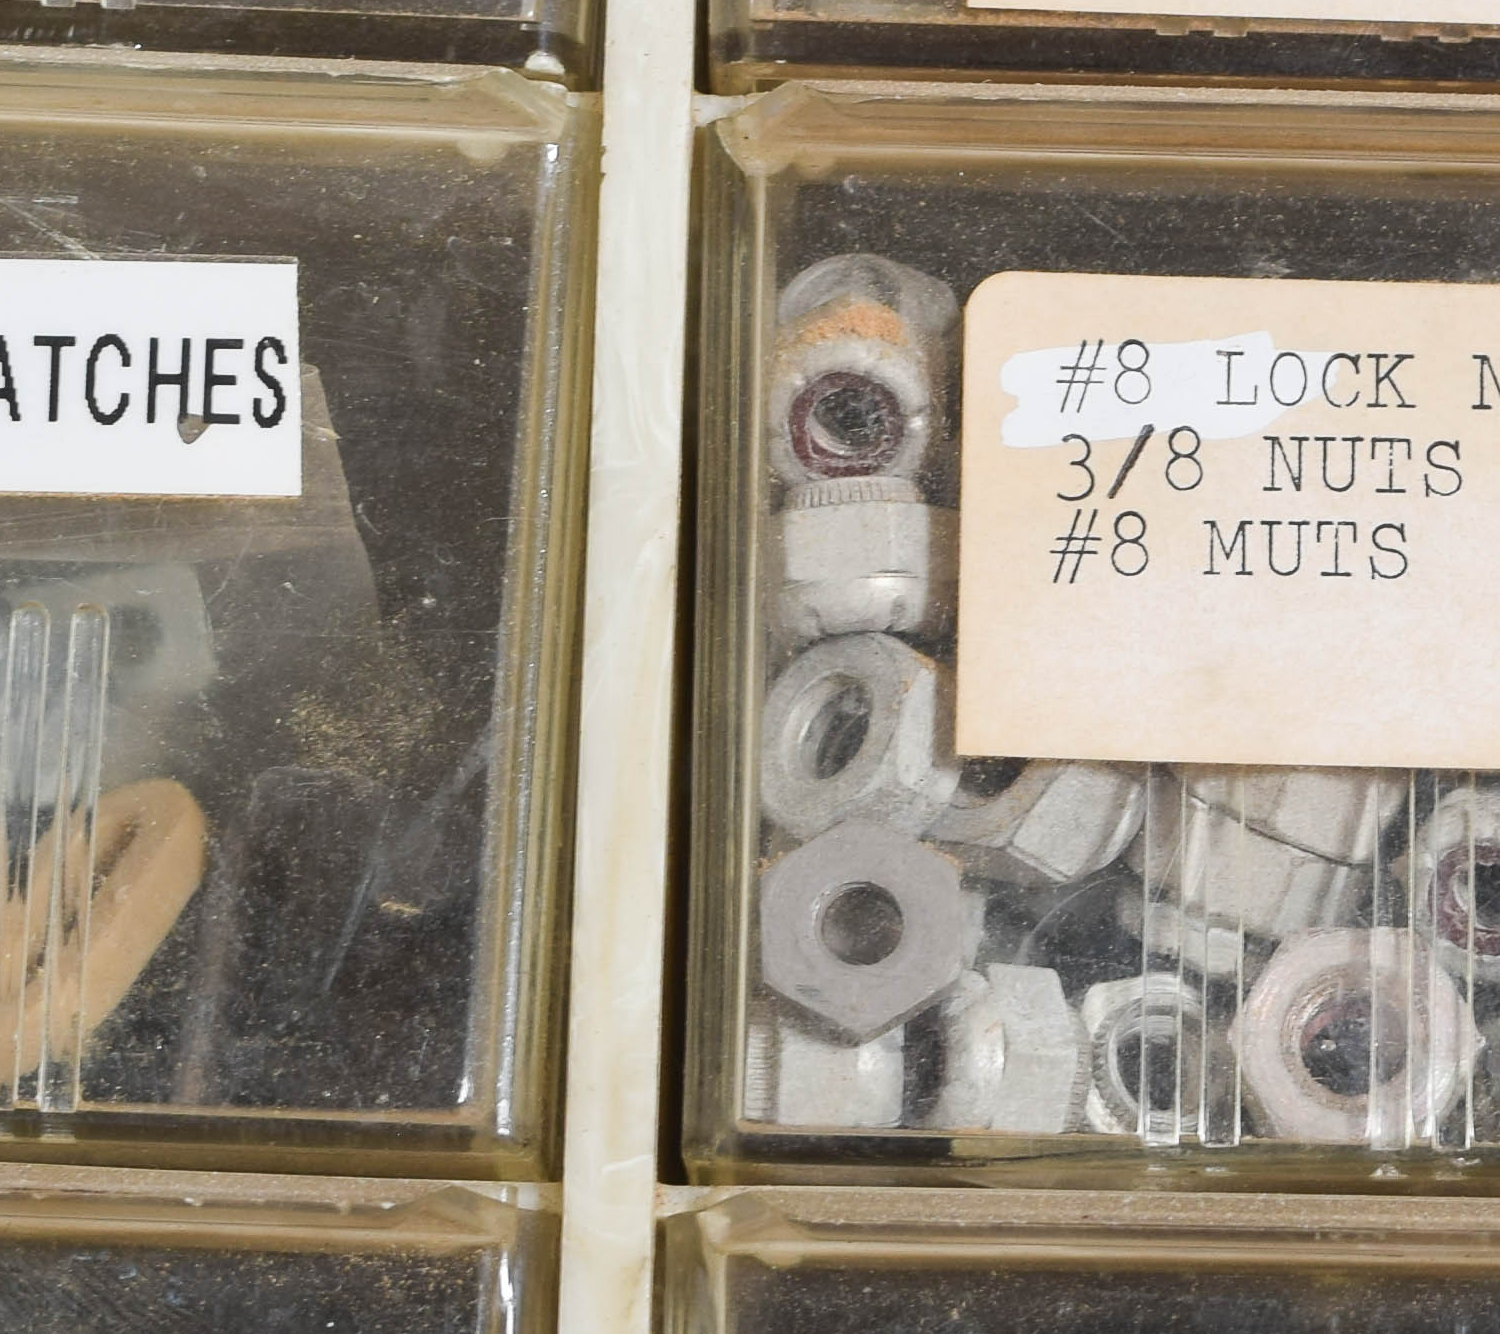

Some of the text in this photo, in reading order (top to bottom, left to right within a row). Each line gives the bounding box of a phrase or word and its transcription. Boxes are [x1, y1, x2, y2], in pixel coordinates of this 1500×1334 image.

[1055, 337, 1152, 414] #8
[1215, 349, 1418, 409] LOCK
[1056, 423, 1464, 502] 3/8 NUTS
[1048, 508, 1409, 585] #8 MUTS
